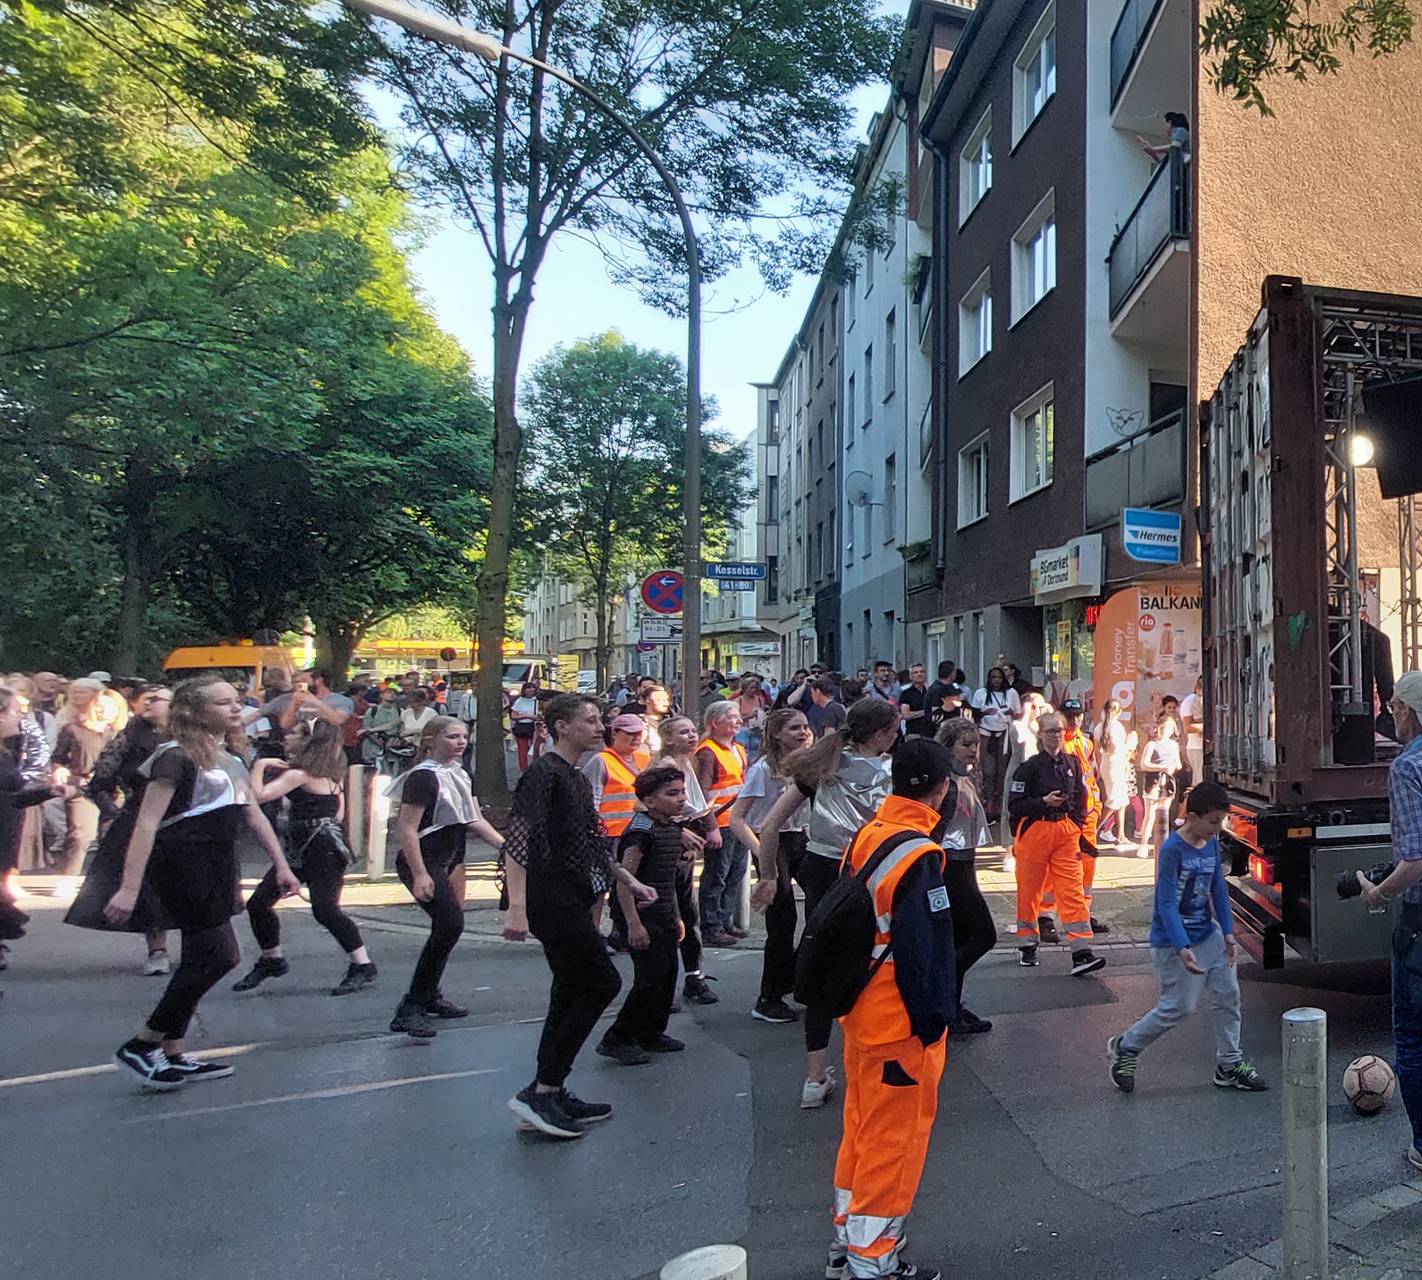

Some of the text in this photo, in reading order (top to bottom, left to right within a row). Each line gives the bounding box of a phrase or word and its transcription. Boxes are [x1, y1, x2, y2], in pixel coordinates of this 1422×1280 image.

[1140, 530, 1178, 543] Hermes
[715, 564, 759, 575] Kesselstr.
[1111, 627, 1126, 675] Money
[1124, 621, 1136, 675] Transfer
